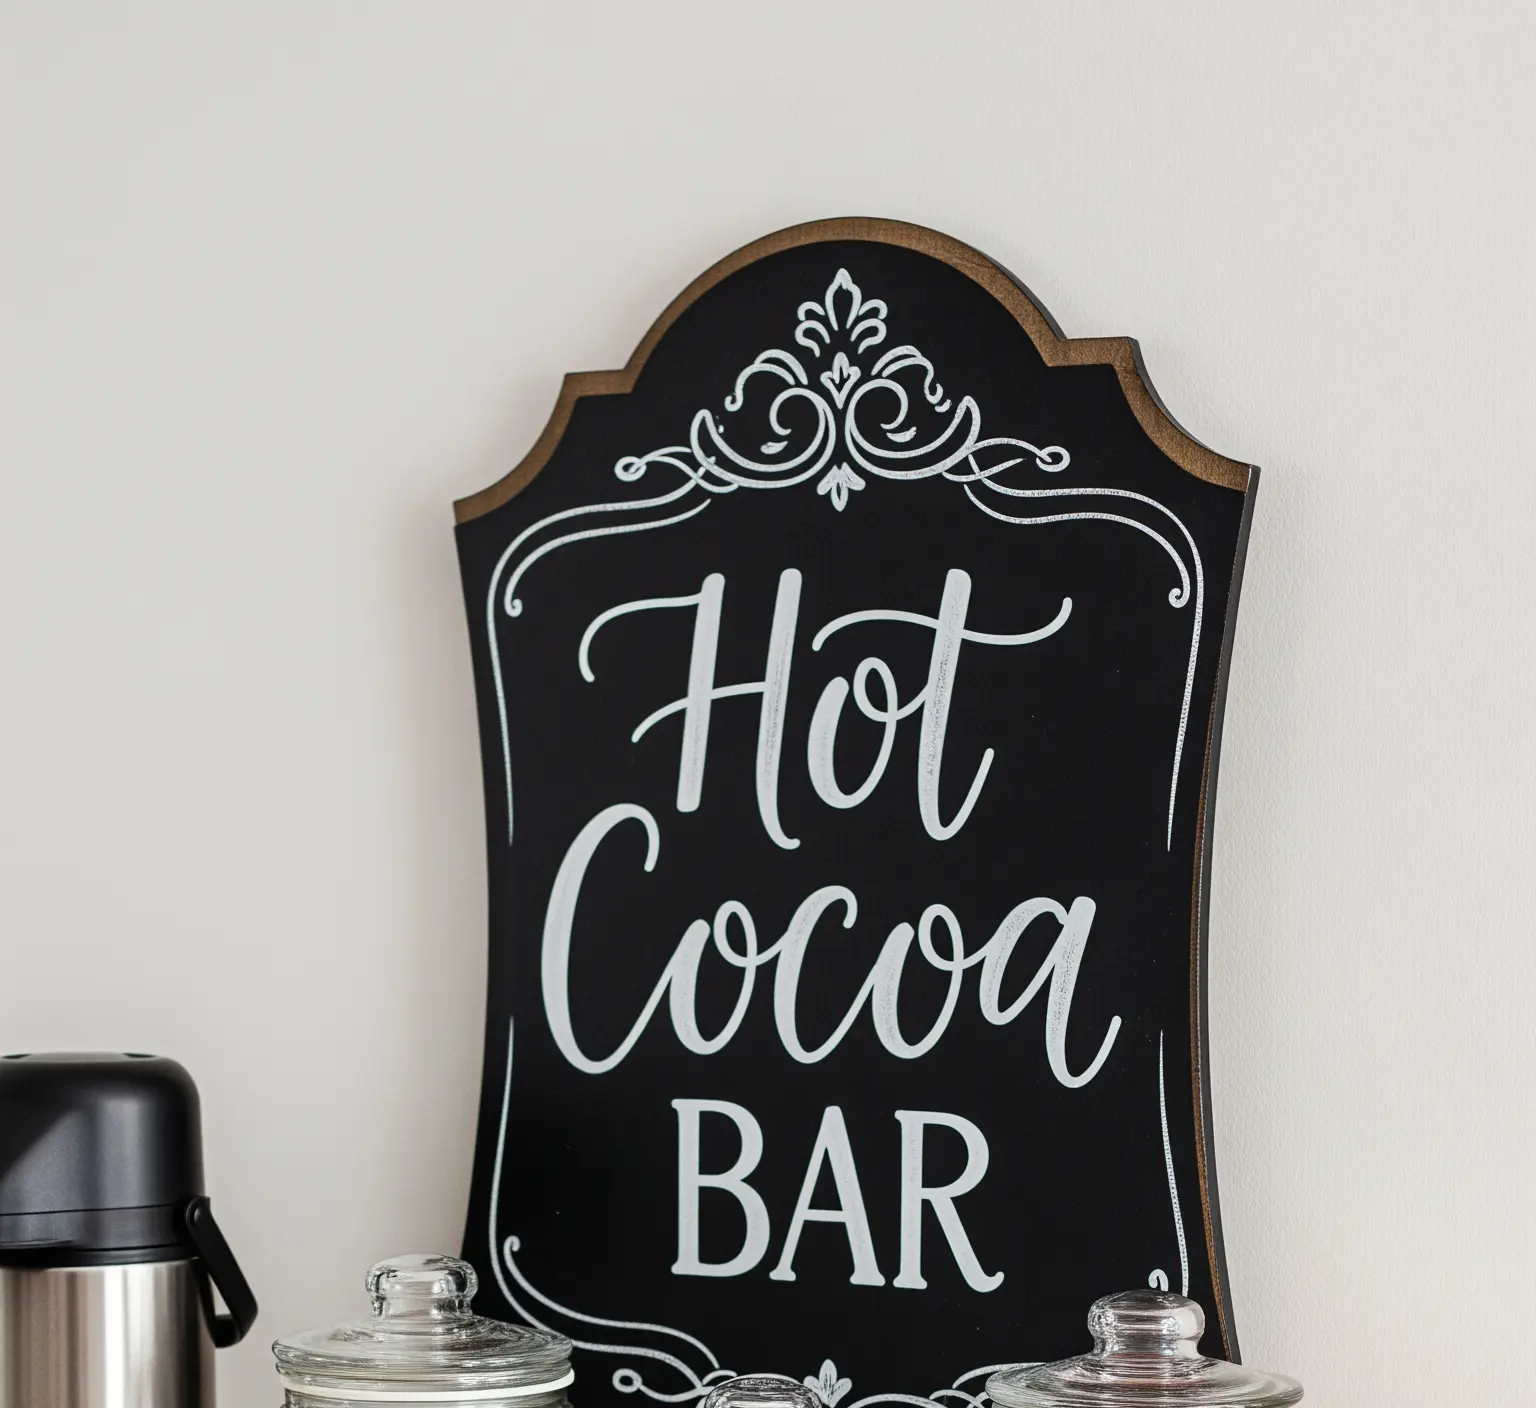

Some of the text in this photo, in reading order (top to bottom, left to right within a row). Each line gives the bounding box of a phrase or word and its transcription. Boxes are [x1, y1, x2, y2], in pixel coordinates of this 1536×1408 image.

[578, 567, 1073, 850] Hot
[541, 803, 1122, 1089] Cocoa
[670, 1098, 1005, 1293] BAR
